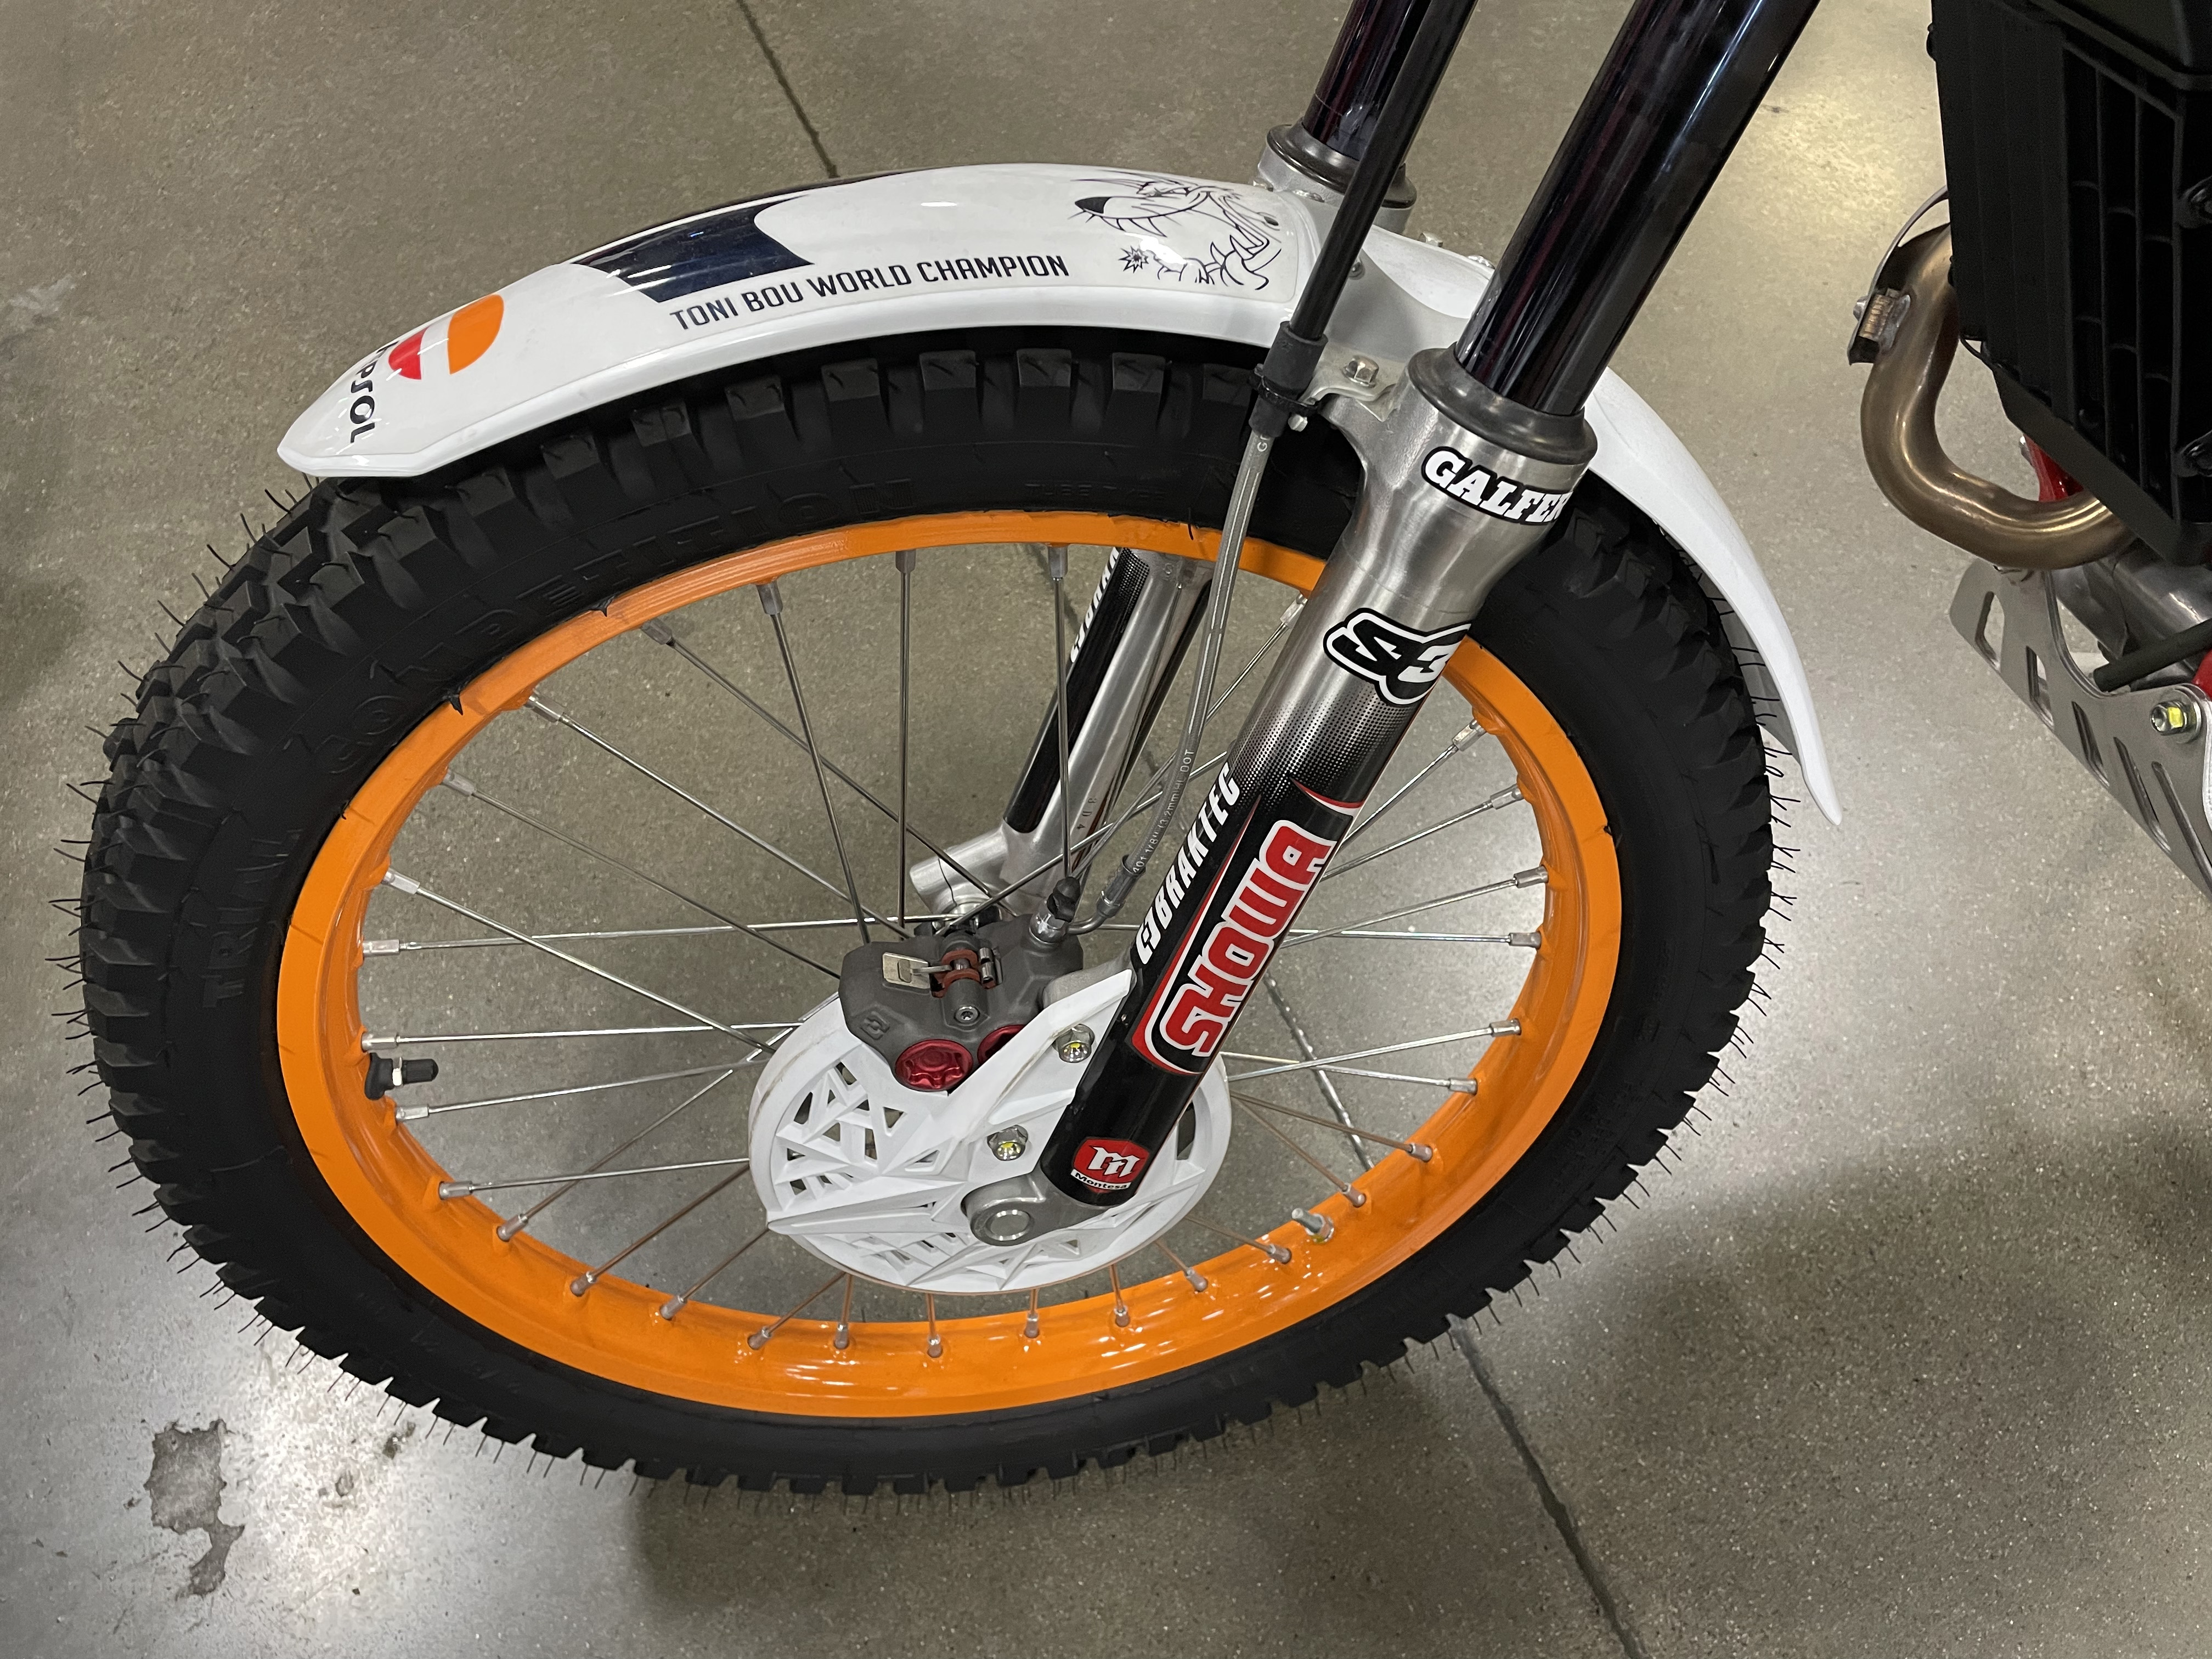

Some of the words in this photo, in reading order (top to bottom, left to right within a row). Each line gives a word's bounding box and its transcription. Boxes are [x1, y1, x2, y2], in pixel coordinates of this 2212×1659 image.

[669, 297, 738, 330] TONI
[741, 281, 803, 312] BOU
[806, 265, 912, 297] WORLD
[916, 255, 1069, 282] CHAMPION
[1180, 749, 1194, 772] DOT
[1154, 761, 1240, 930] BRAKTEC
[1160, 820, 1337, 1057] SHOWA
[1075, 1172, 1127, 1189] Montesa
